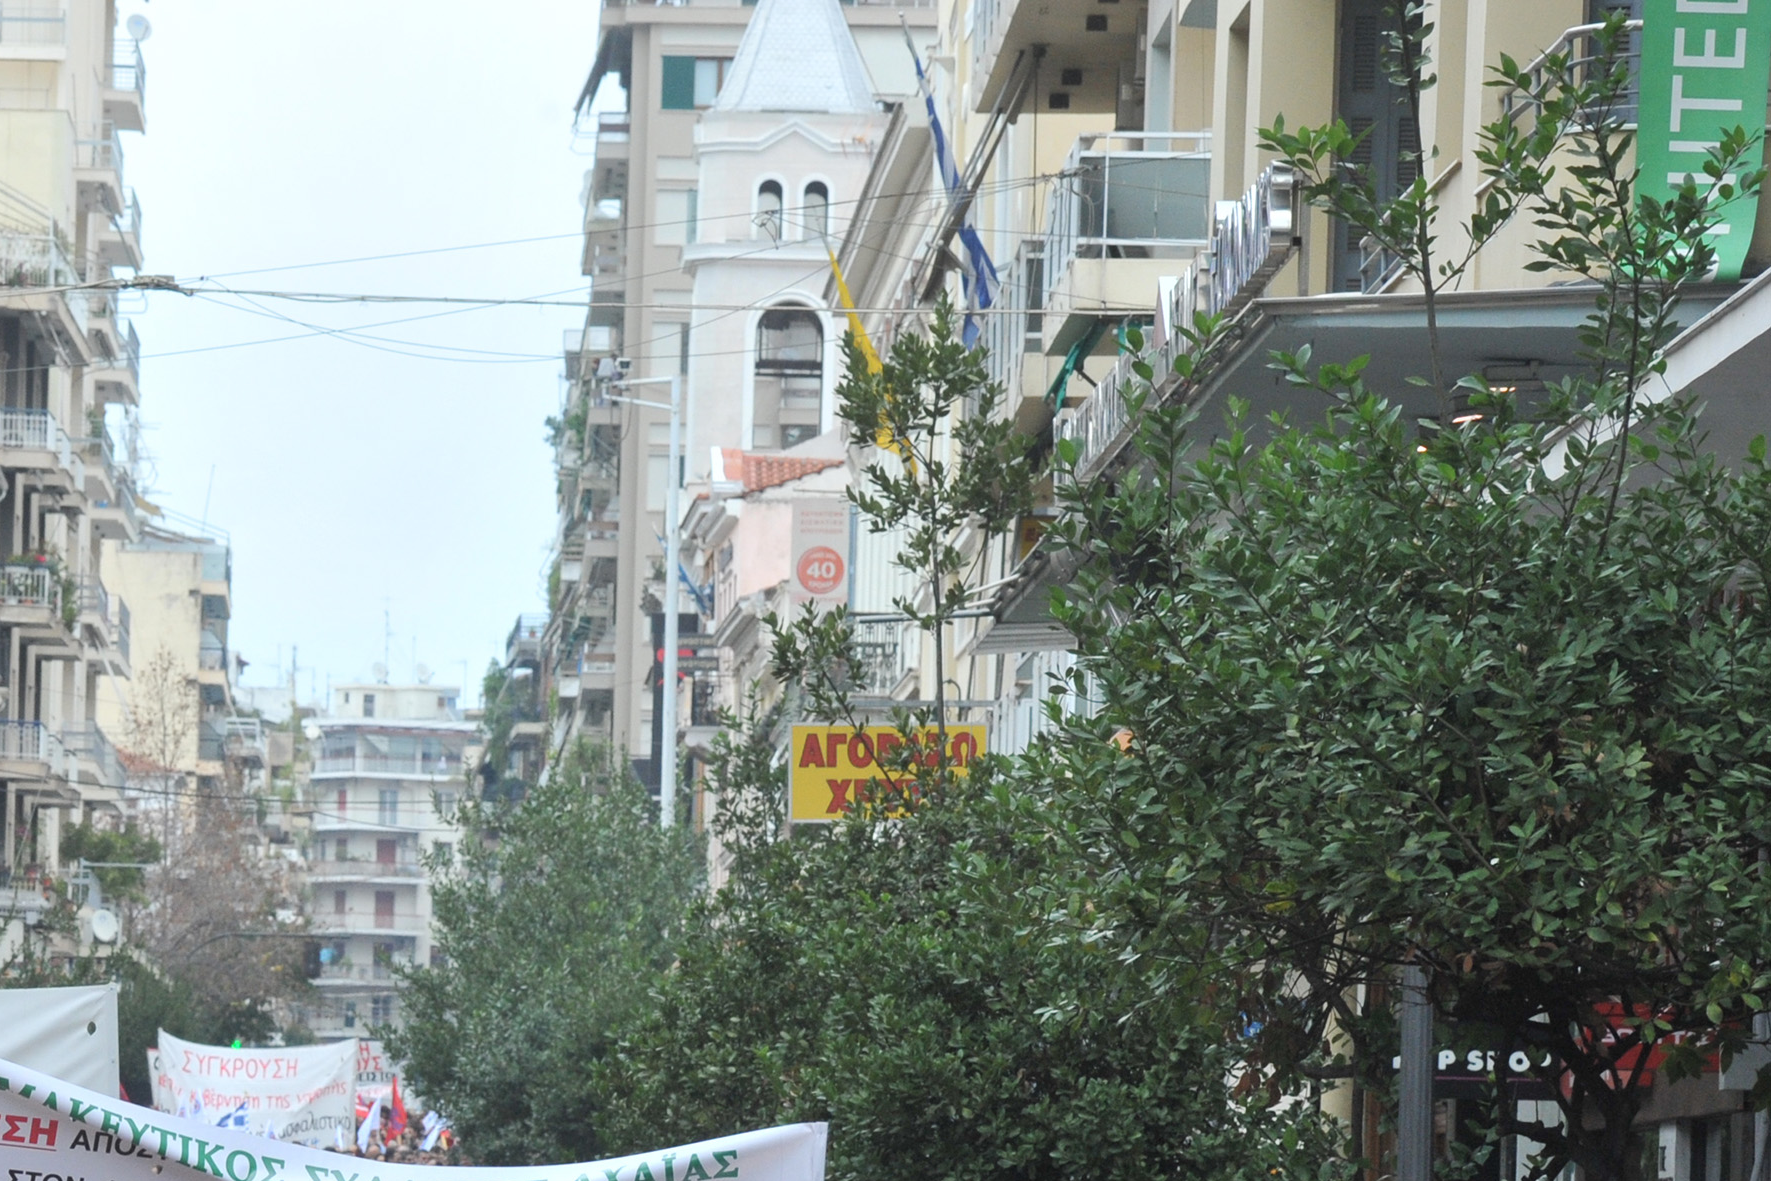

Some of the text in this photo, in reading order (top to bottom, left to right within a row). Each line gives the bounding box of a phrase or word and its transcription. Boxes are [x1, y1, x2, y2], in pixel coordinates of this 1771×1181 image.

[806, 561, 836, 579] 40
[182, 1050, 298, 1079] ΣΥΓΚΡΟΥΣΗ
[189, 1087, 260, 1112] κβέρνηση
